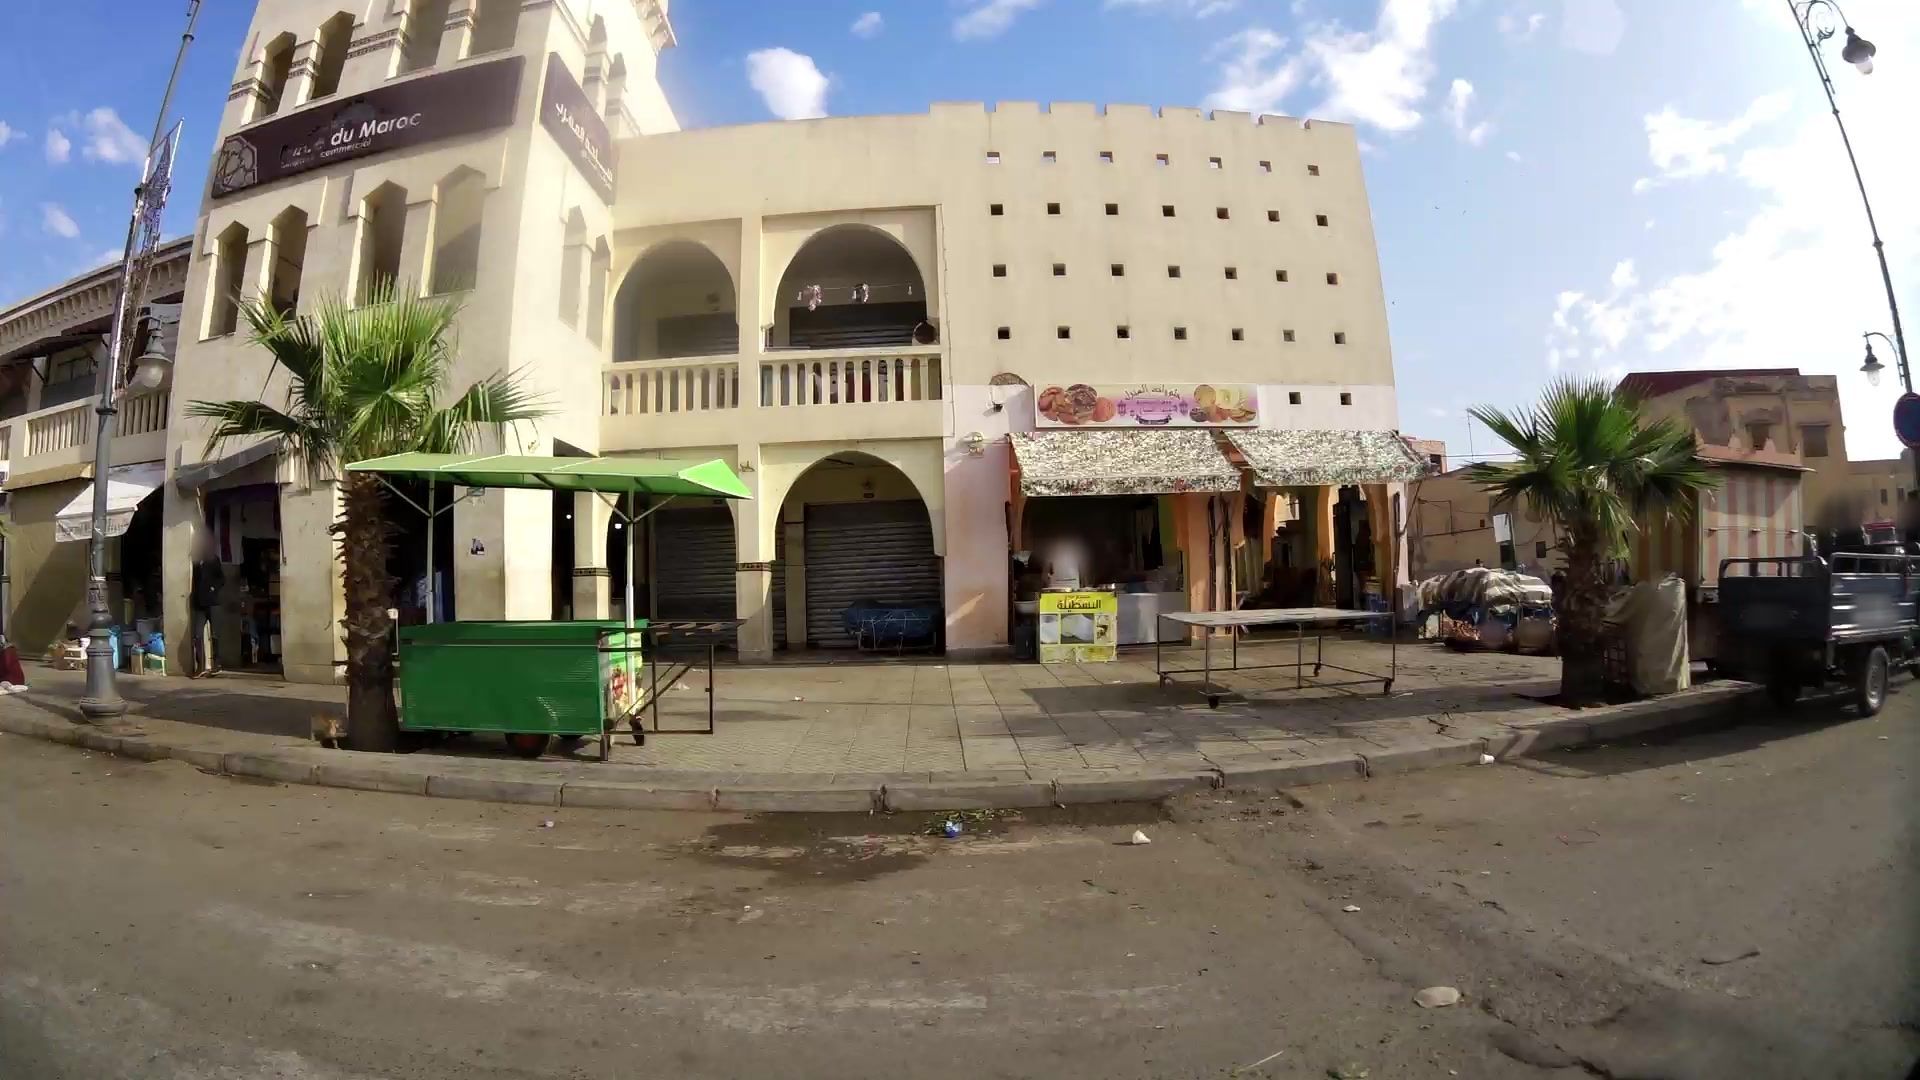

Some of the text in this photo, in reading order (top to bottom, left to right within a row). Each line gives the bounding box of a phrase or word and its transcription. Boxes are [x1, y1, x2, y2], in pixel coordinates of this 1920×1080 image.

[331, 113, 422, 146] du Maroc
[320, 137, 371, 158] commercial
